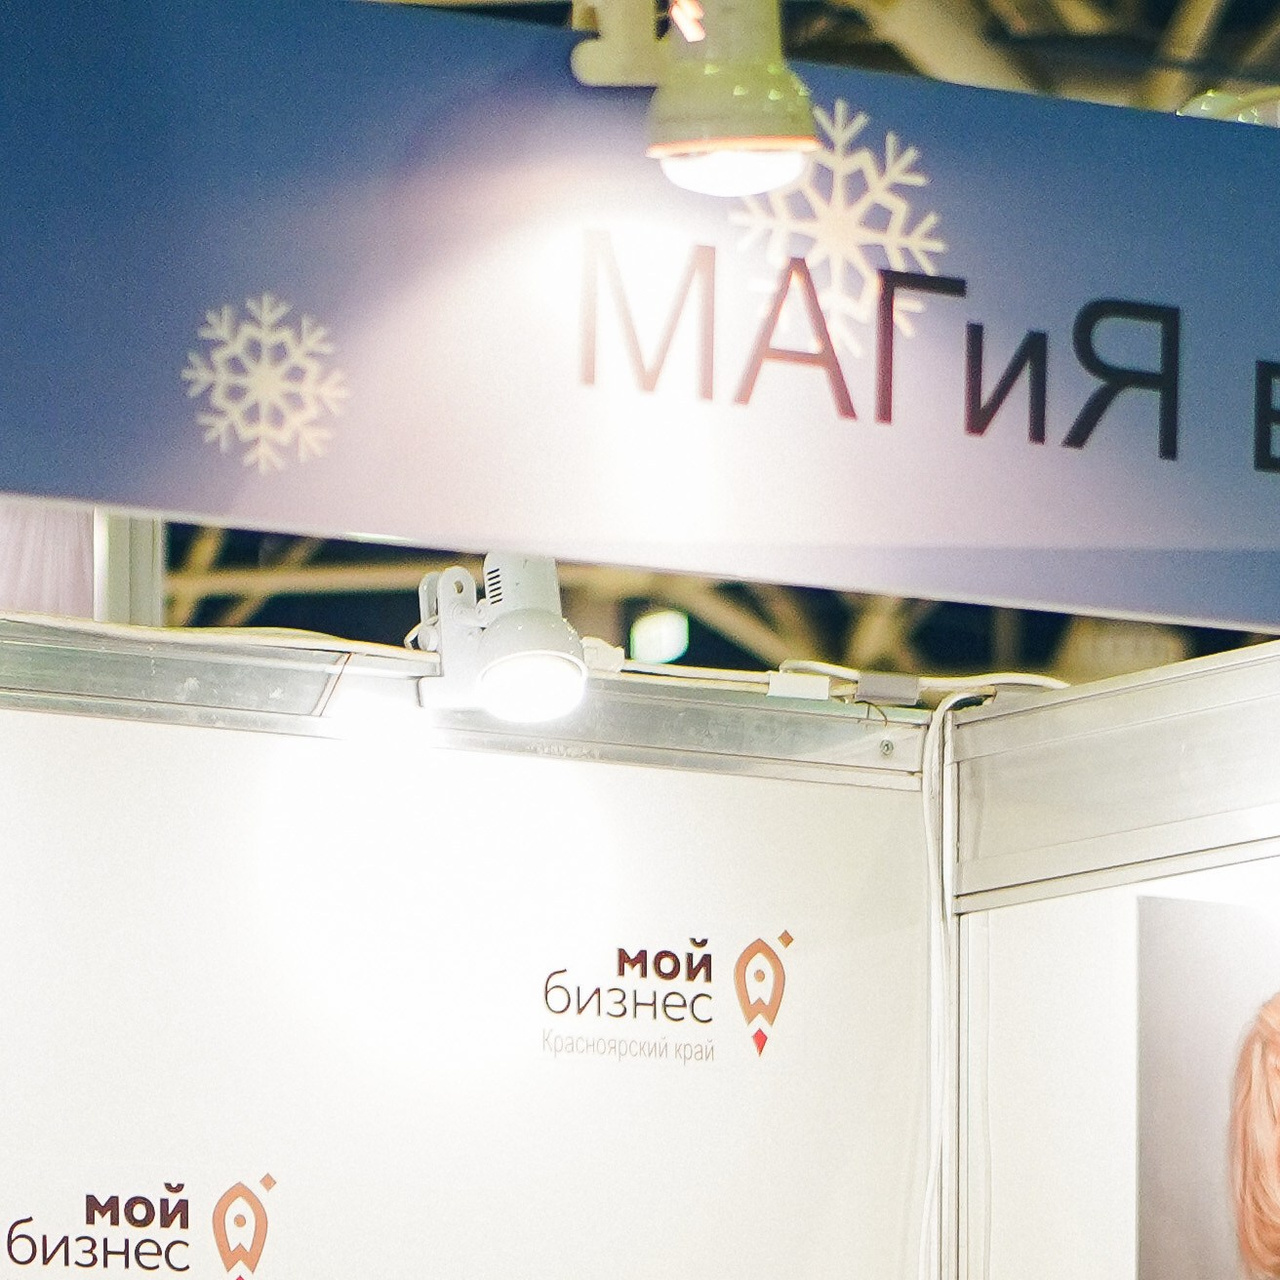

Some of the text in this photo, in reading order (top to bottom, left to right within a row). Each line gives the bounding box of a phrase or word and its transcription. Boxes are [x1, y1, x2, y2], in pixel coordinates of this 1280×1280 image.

[579, 228, 1183, 463] МАГиЯ
[616, 937, 712, 983] мой
[544, 968, 713, 1024] бизнес
[541, 1028, 715, 1066] Красноярский край
[85, 1182, 189, 1230] мой
[6, 1216, 190, 1272] бизнес
